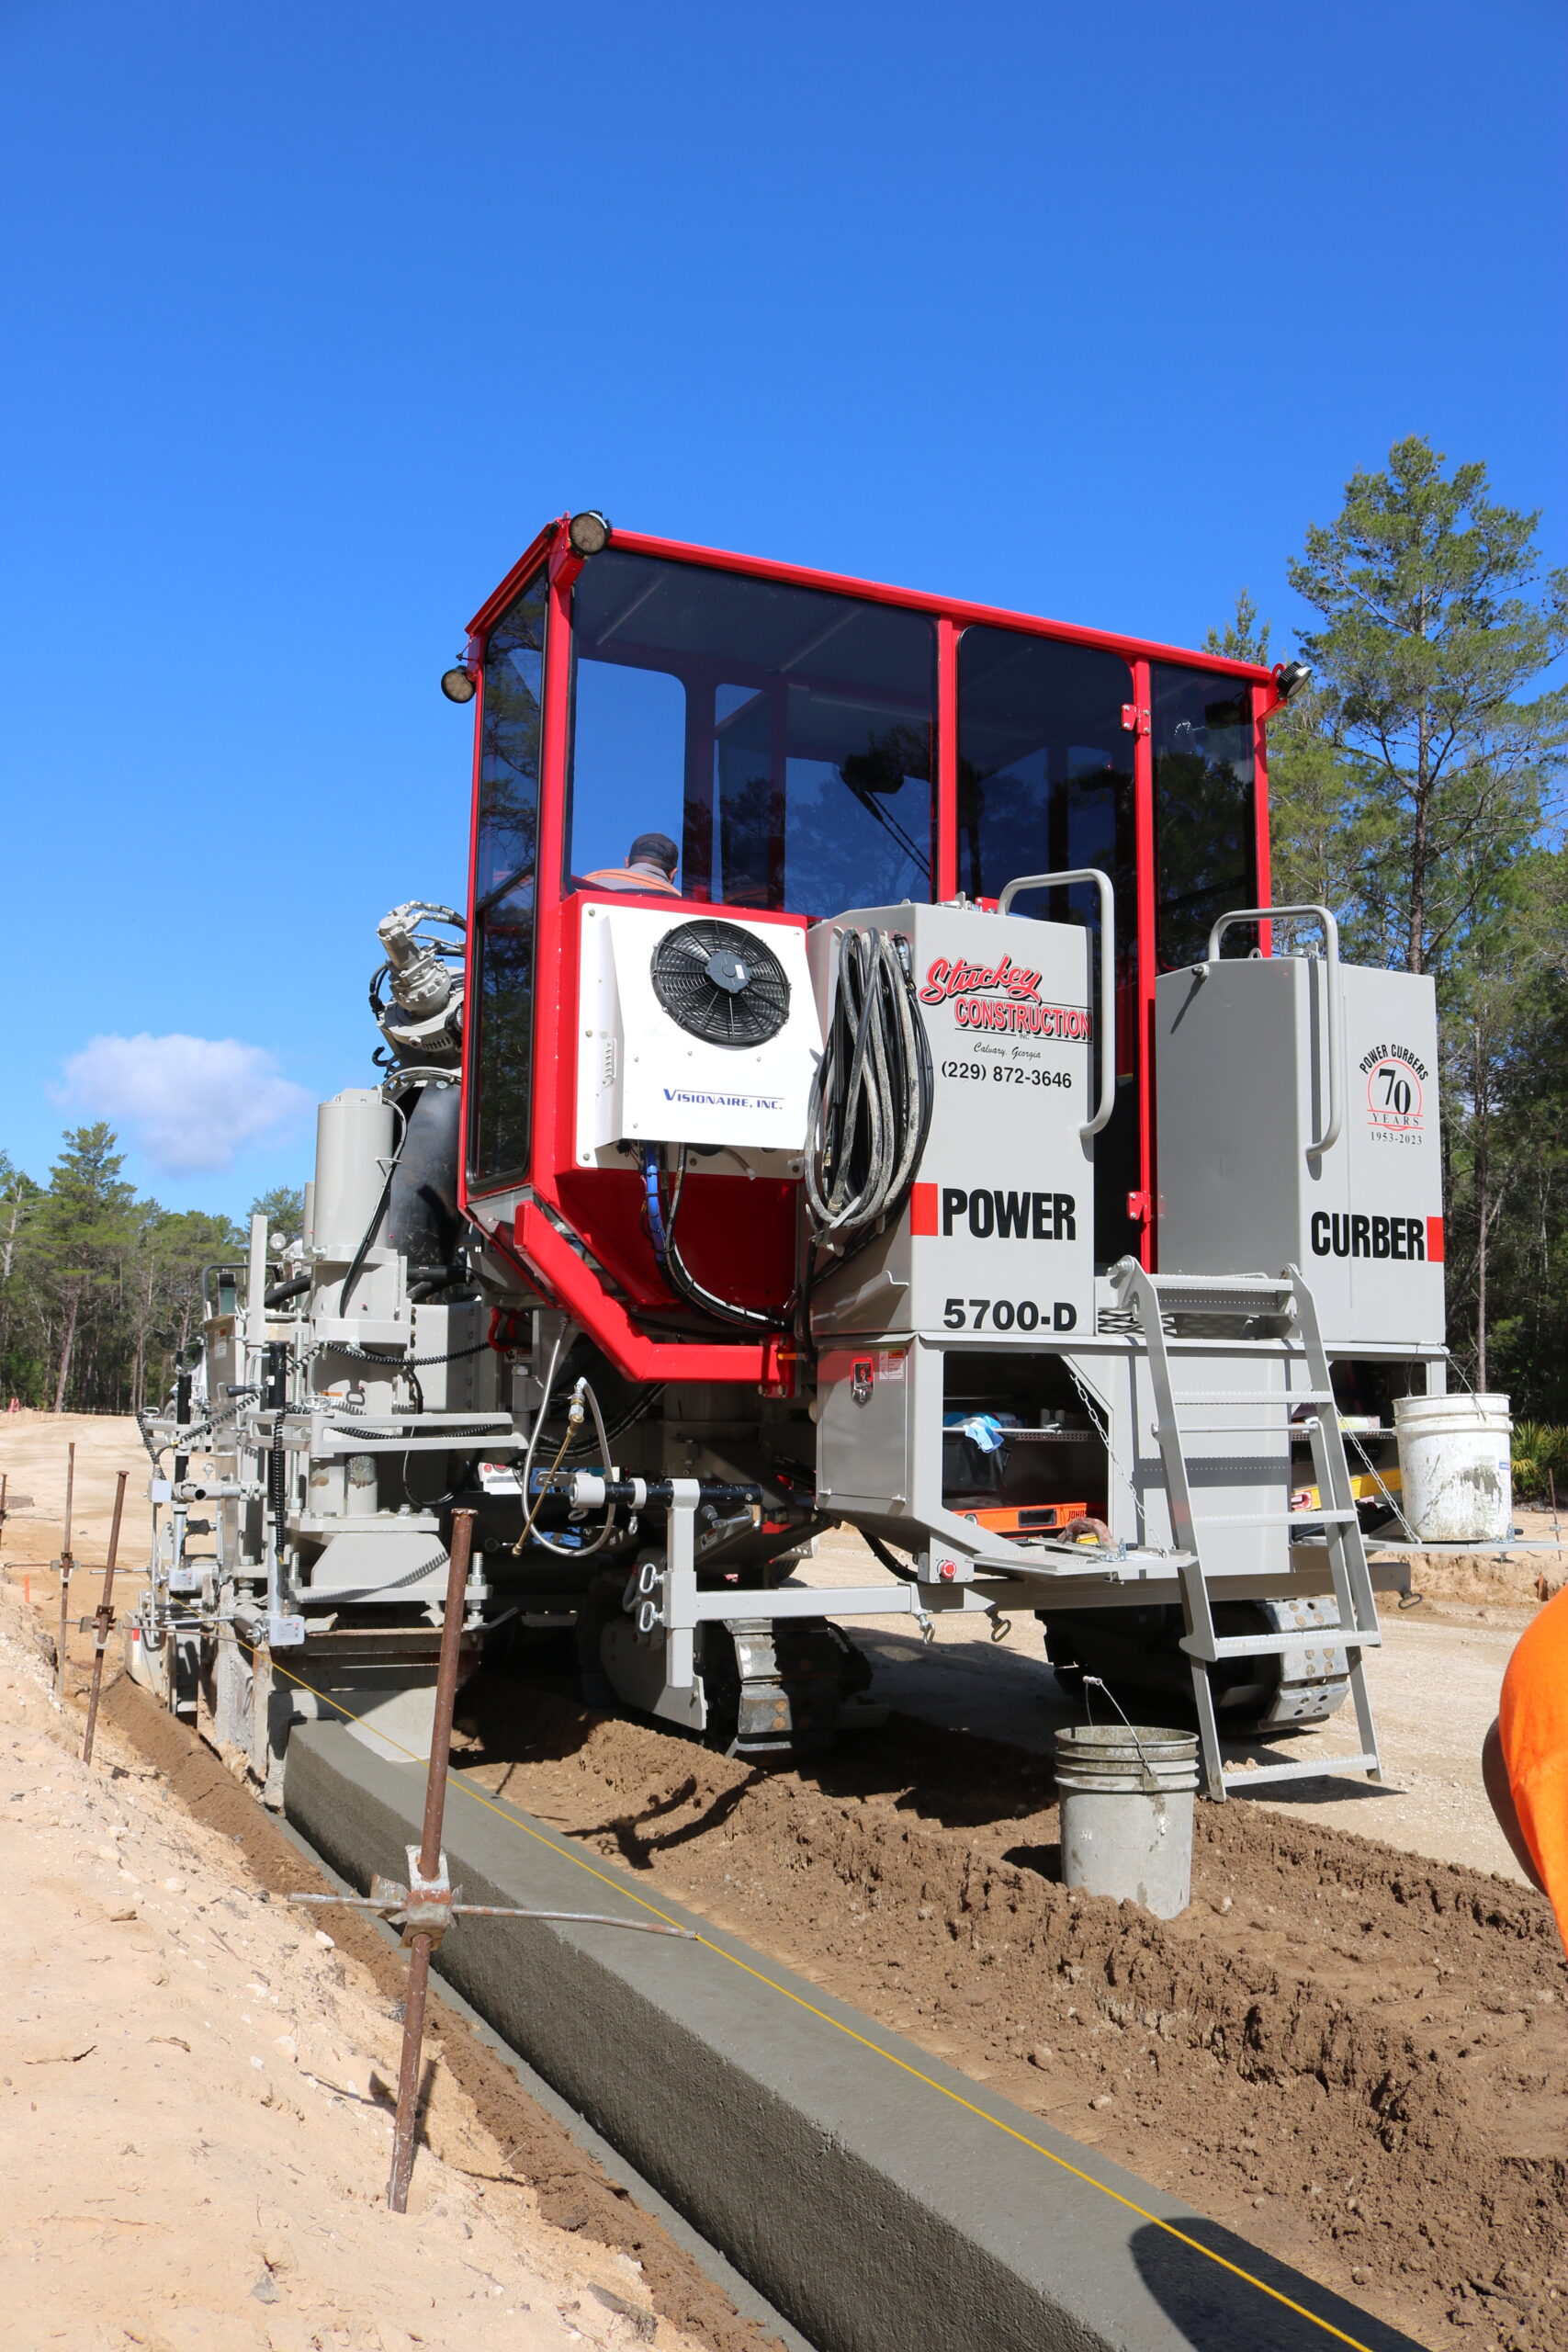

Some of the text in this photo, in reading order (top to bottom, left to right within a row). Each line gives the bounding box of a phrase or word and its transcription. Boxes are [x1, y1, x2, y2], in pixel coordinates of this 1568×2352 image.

[919, 954, 1043, 1006] Stuckey
[954, 998, 1092, 1041] CONSTRUCTION
[1011, 1046, 1042, 1061] Georgia
[1359, 1044, 1429, 1081] POWER CURBERS
[941, 1061, 1072, 1089] (229) 872-3646
[1378, 1068, 1411, 1115] 70
[756, 1100, 783, 1110] INC.
[1372, 1113, 1420, 1126] YEARS
[1371, 1131, 1423, 1146] 1953-2023
[942, 1187, 1077, 1240] POWER
[1311, 1211, 1425, 1261] CURBER
[942, 1298, 1077, 1332] 5700-D
